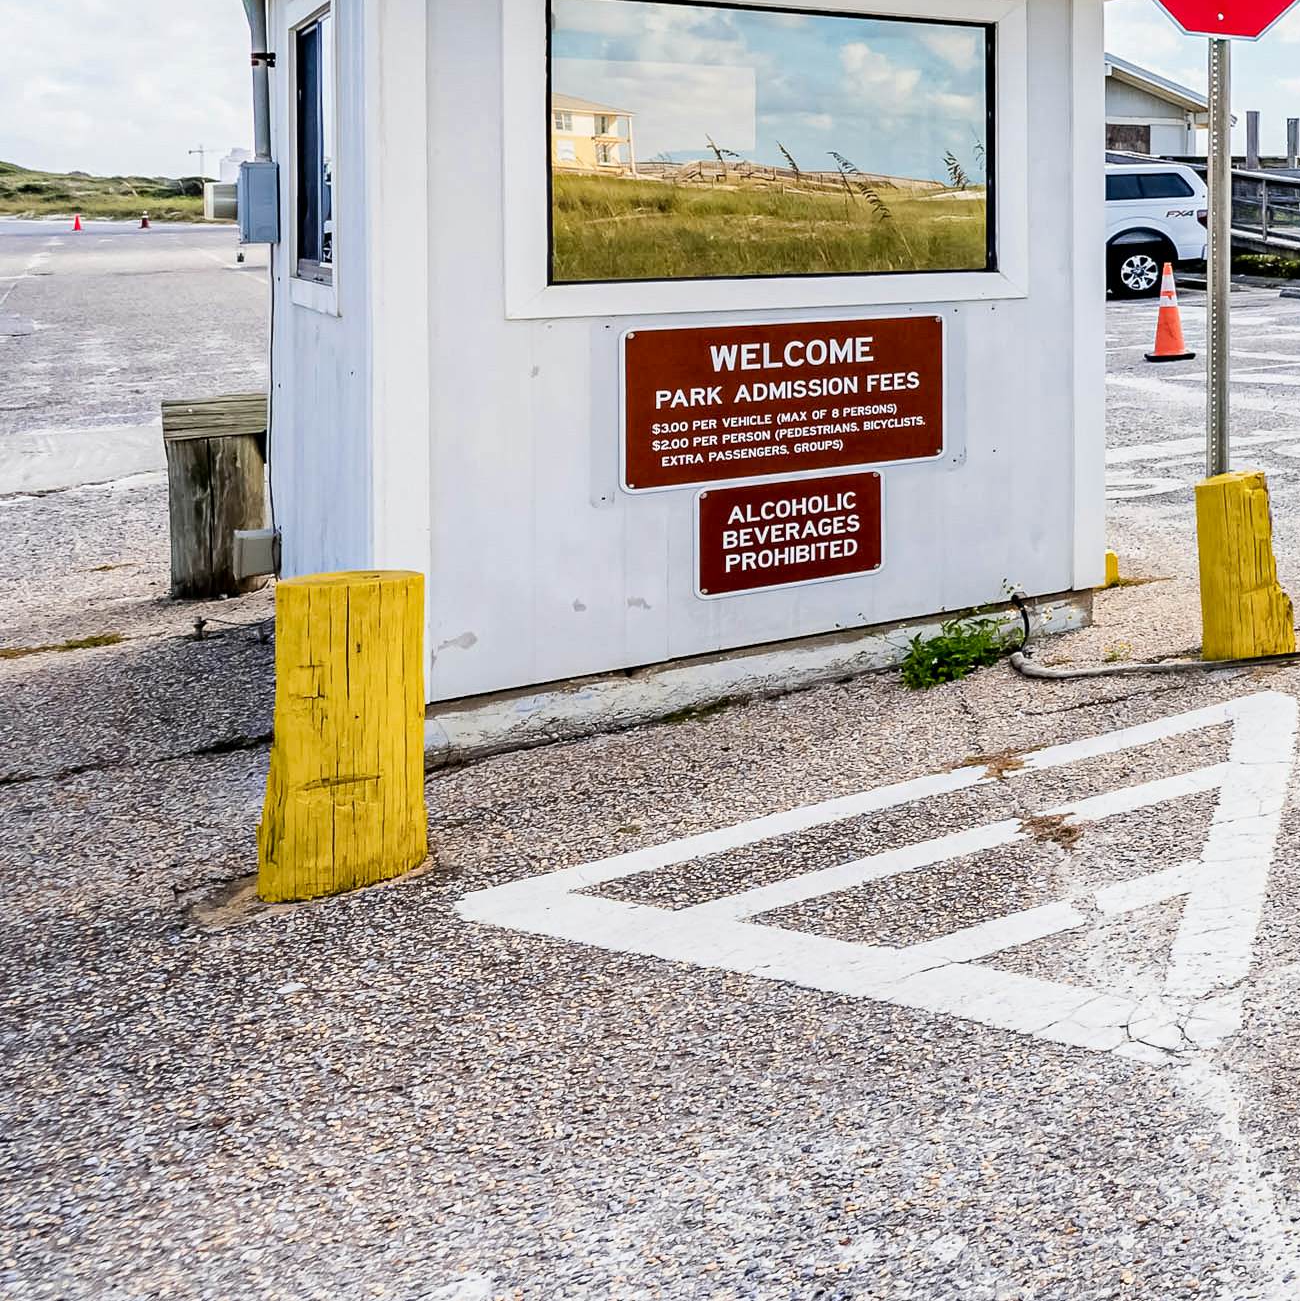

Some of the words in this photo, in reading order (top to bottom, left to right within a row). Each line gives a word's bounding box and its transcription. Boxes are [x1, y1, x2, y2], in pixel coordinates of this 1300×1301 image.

[1166, 210, 1194, 218] FX4
[709, 336, 874, 373] WELCOME
[655, 386, 723, 409] PARK
[734, 376, 858, 404] ADMISSION
[866, 371, 920, 392] FEES
[651, 422, 688, 435] $3.00
[692, 419, 717, 431] PER
[722, 414, 772, 428] VEHICLE
[776, 411, 807, 425] (MAX
[812, 410, 827, 420] OF
[832, 408, 839, 418] 8
[843, 403, 898, 417] PERSONS)
[652, 439, 689, 451] $2.00
[693, 435, 717, 447] PER
[722, 431, 771, 444] PERSON
[661, 453, 704, 467] EXTRA
[793, 440, 844, 454] GROUPS)
[727, 491, 857, 524] ALCOHOLIC
[722, 515, 860, 549] BEVERAGES
[725, 539, 858, 573] PROHIBITED
